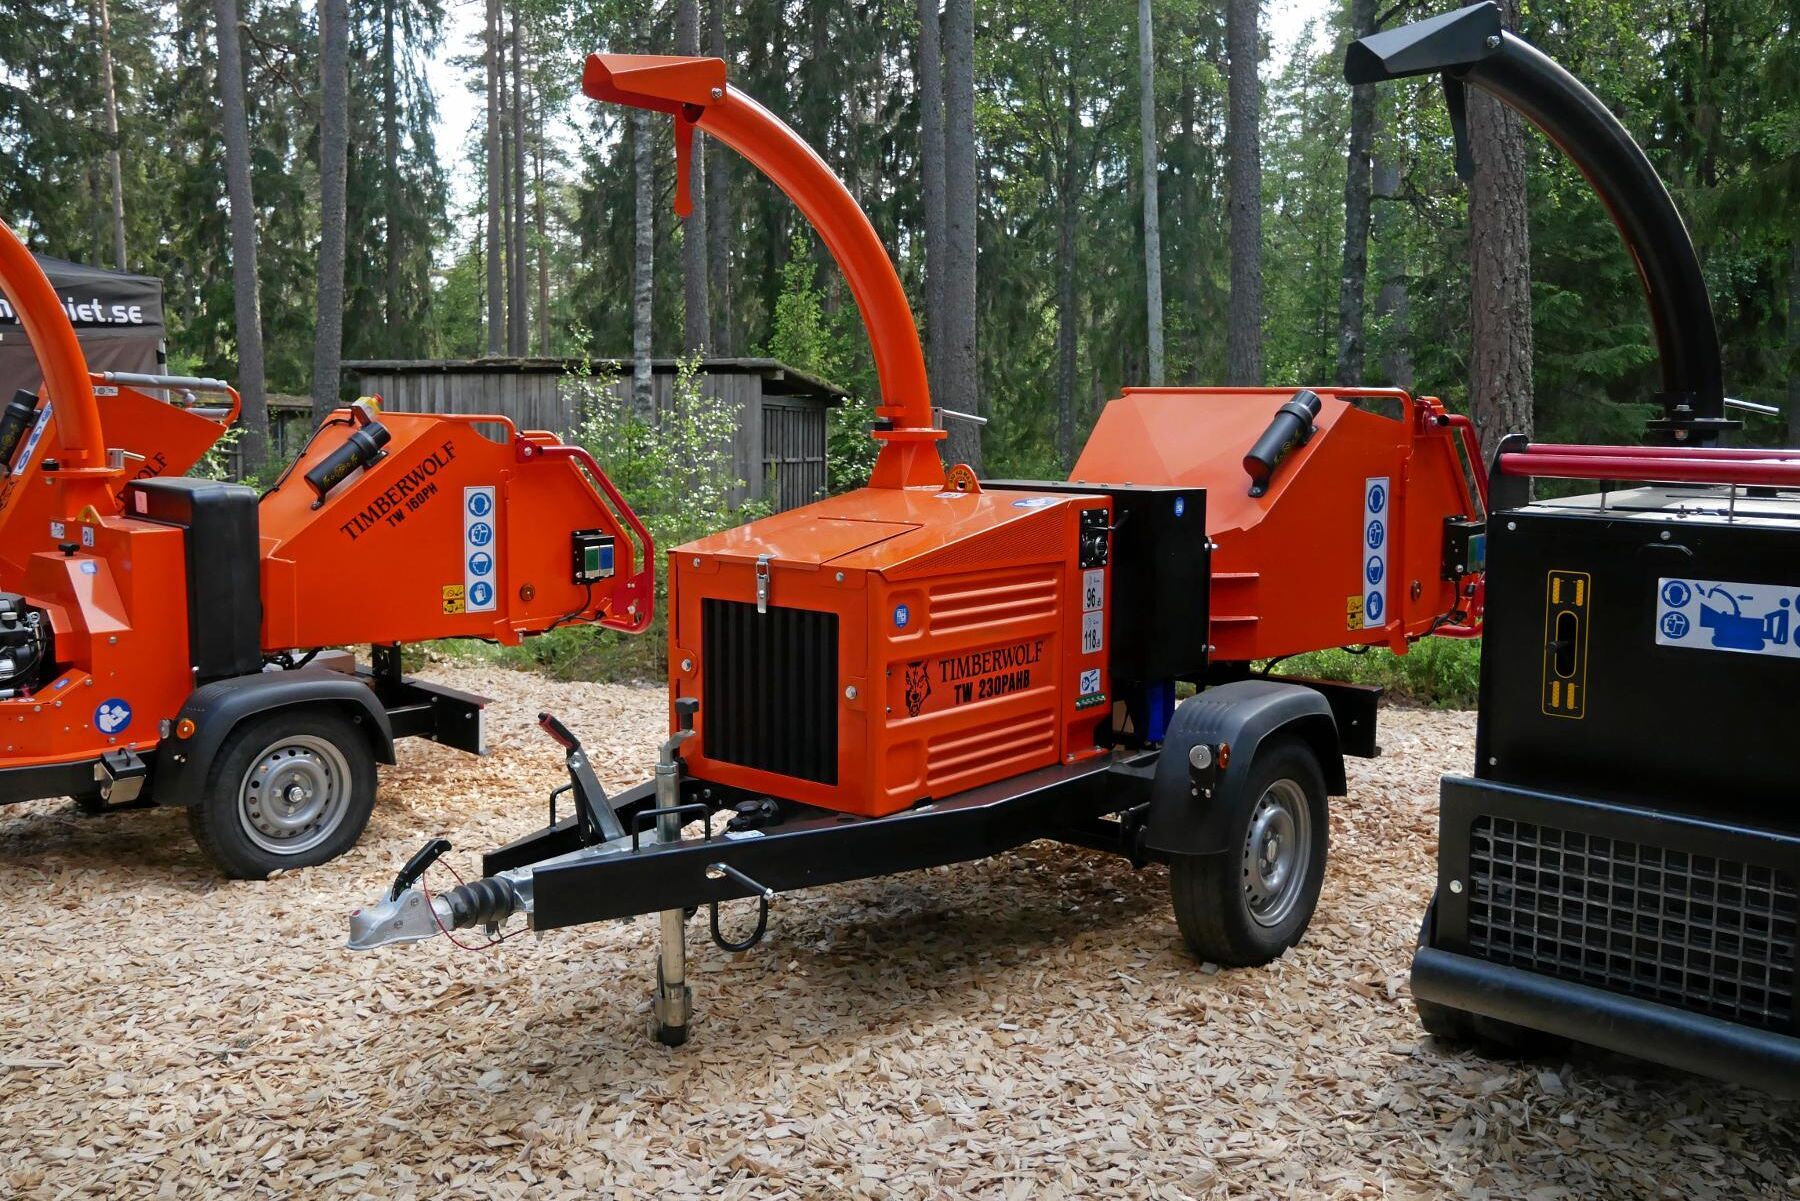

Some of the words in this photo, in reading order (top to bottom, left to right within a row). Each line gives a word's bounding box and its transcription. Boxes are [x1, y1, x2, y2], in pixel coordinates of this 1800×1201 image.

[340, 440, 456, 540] TIMBERWOLF
[385, 508, 406, 528] TW
[405, 482, 439, 512] 160PH
[1086, 588, 1096, 608] 96
[1084, 629, 1096, 651] 118
[939, 640, 1044, 683] TIMBERWOLF
[954, 682, 973, 704] TW
[978, 670, 1030, 699] 230PAHB
